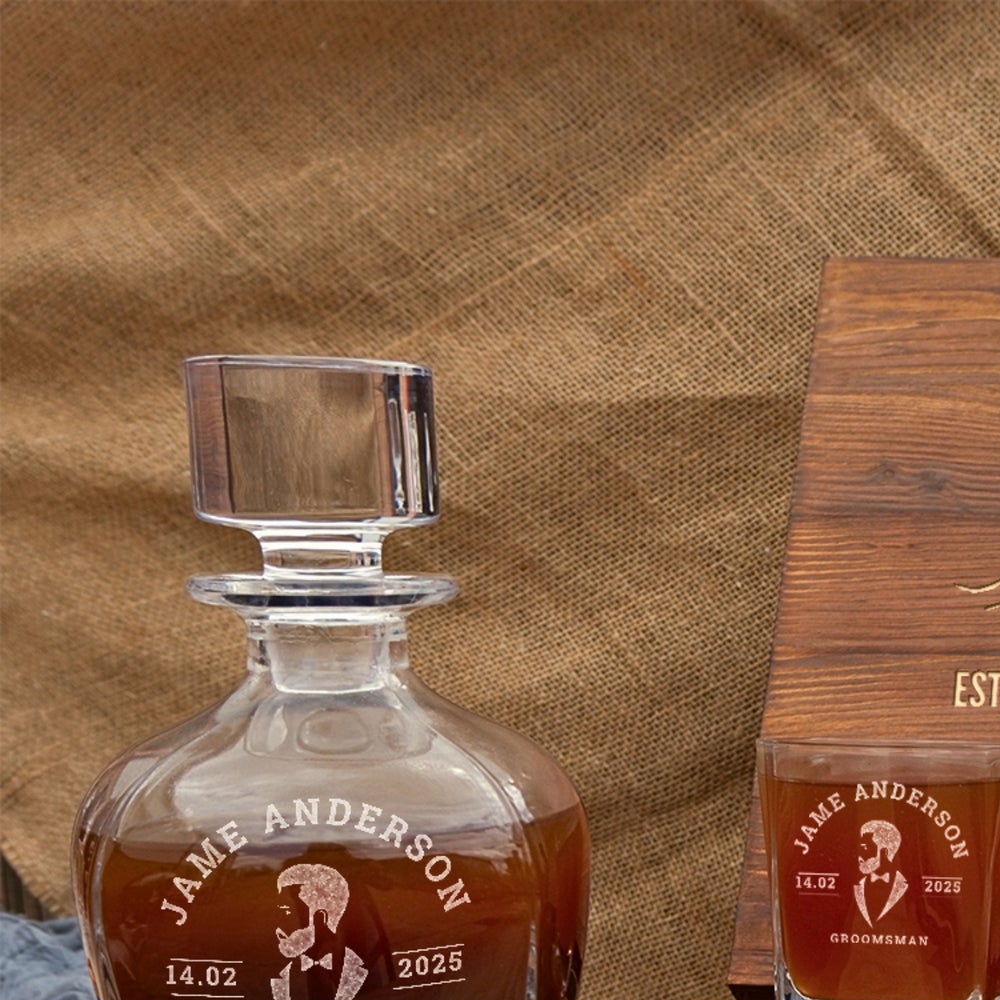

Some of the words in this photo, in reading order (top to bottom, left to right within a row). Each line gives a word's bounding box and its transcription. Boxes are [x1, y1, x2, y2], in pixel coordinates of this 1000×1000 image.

[793, 792, 846, 855] JAME
[854, 780, 969, 859] ANDERSON
[160, 820, 249, 926] JAME
[264, 797, 472, 912] ANDERSON
[795, 876, 836, 889] 14.02
[924, 880, 961, 893] 2025
[830, 933, 929, 946] GROOMSMAN
[165, 964, 238, 987] 14.02
[398, 951, 463, 979] 2025
